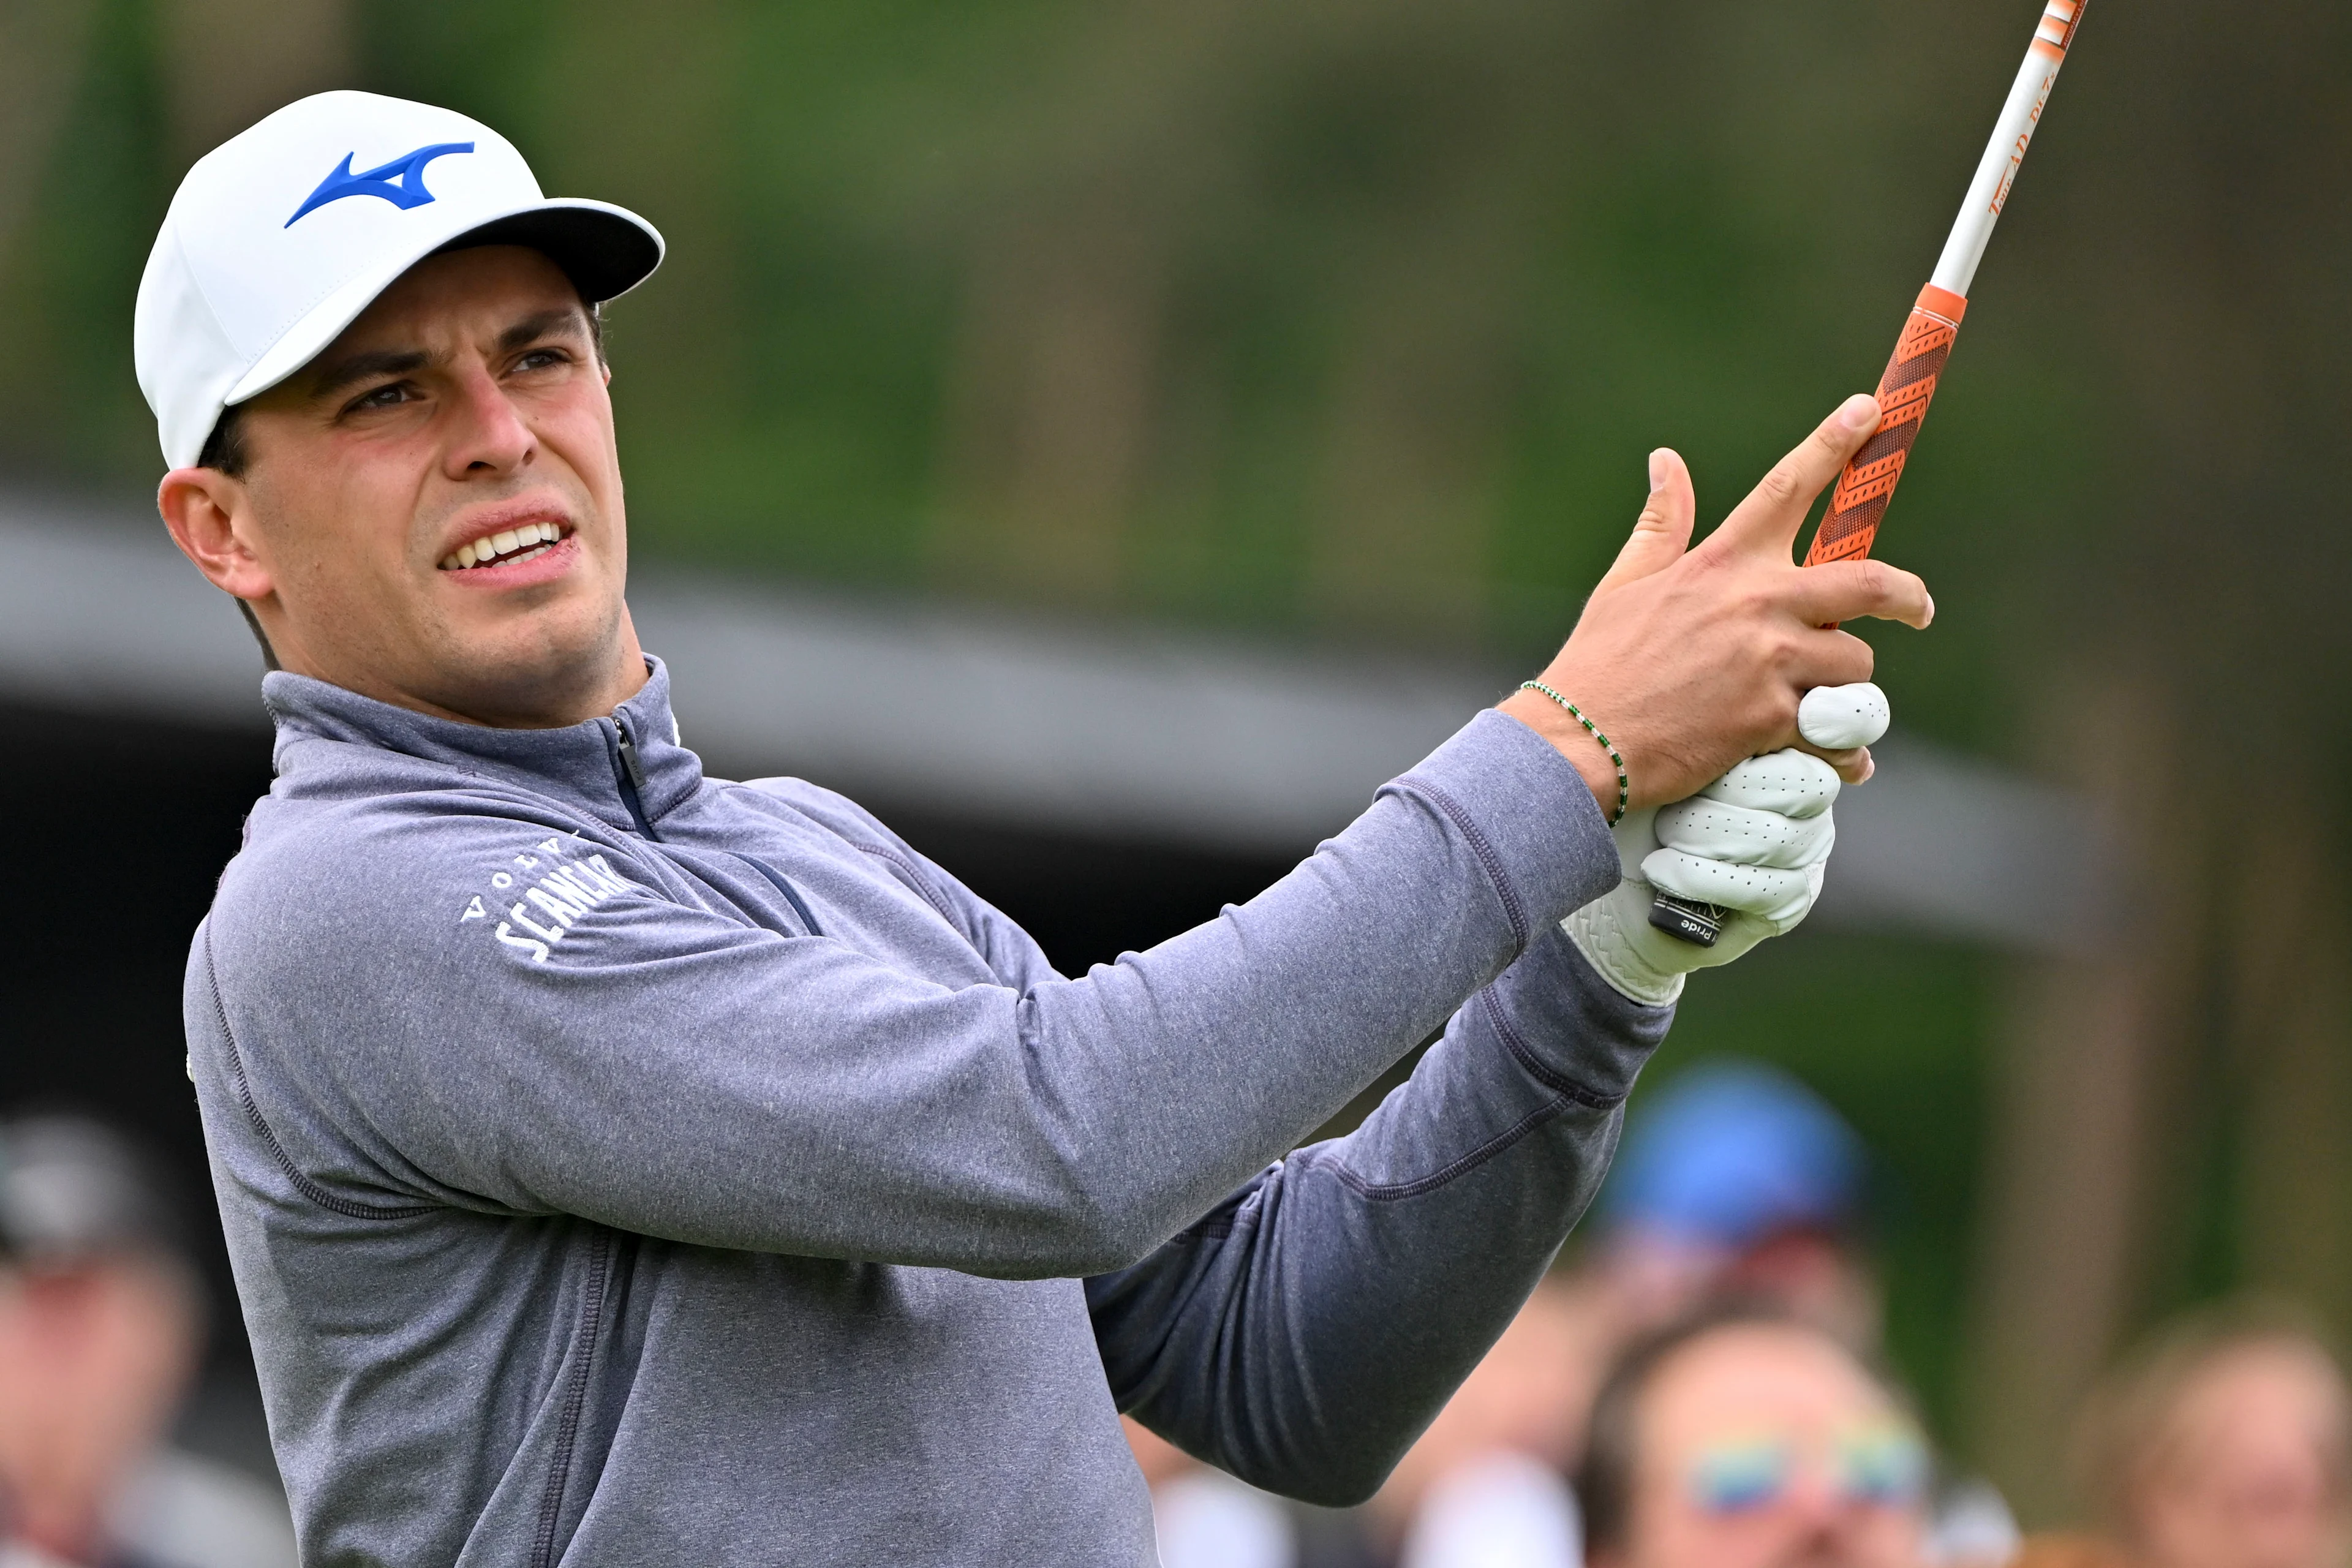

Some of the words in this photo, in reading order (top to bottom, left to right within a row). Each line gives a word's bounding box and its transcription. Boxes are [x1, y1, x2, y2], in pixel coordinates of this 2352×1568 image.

[1988, 162, 2011, 216] Tour
[2011, 134, 2028, 174] AD
[460, 829, 582, 922] VOLV
[1681, 919, 1713, 940] Pride
